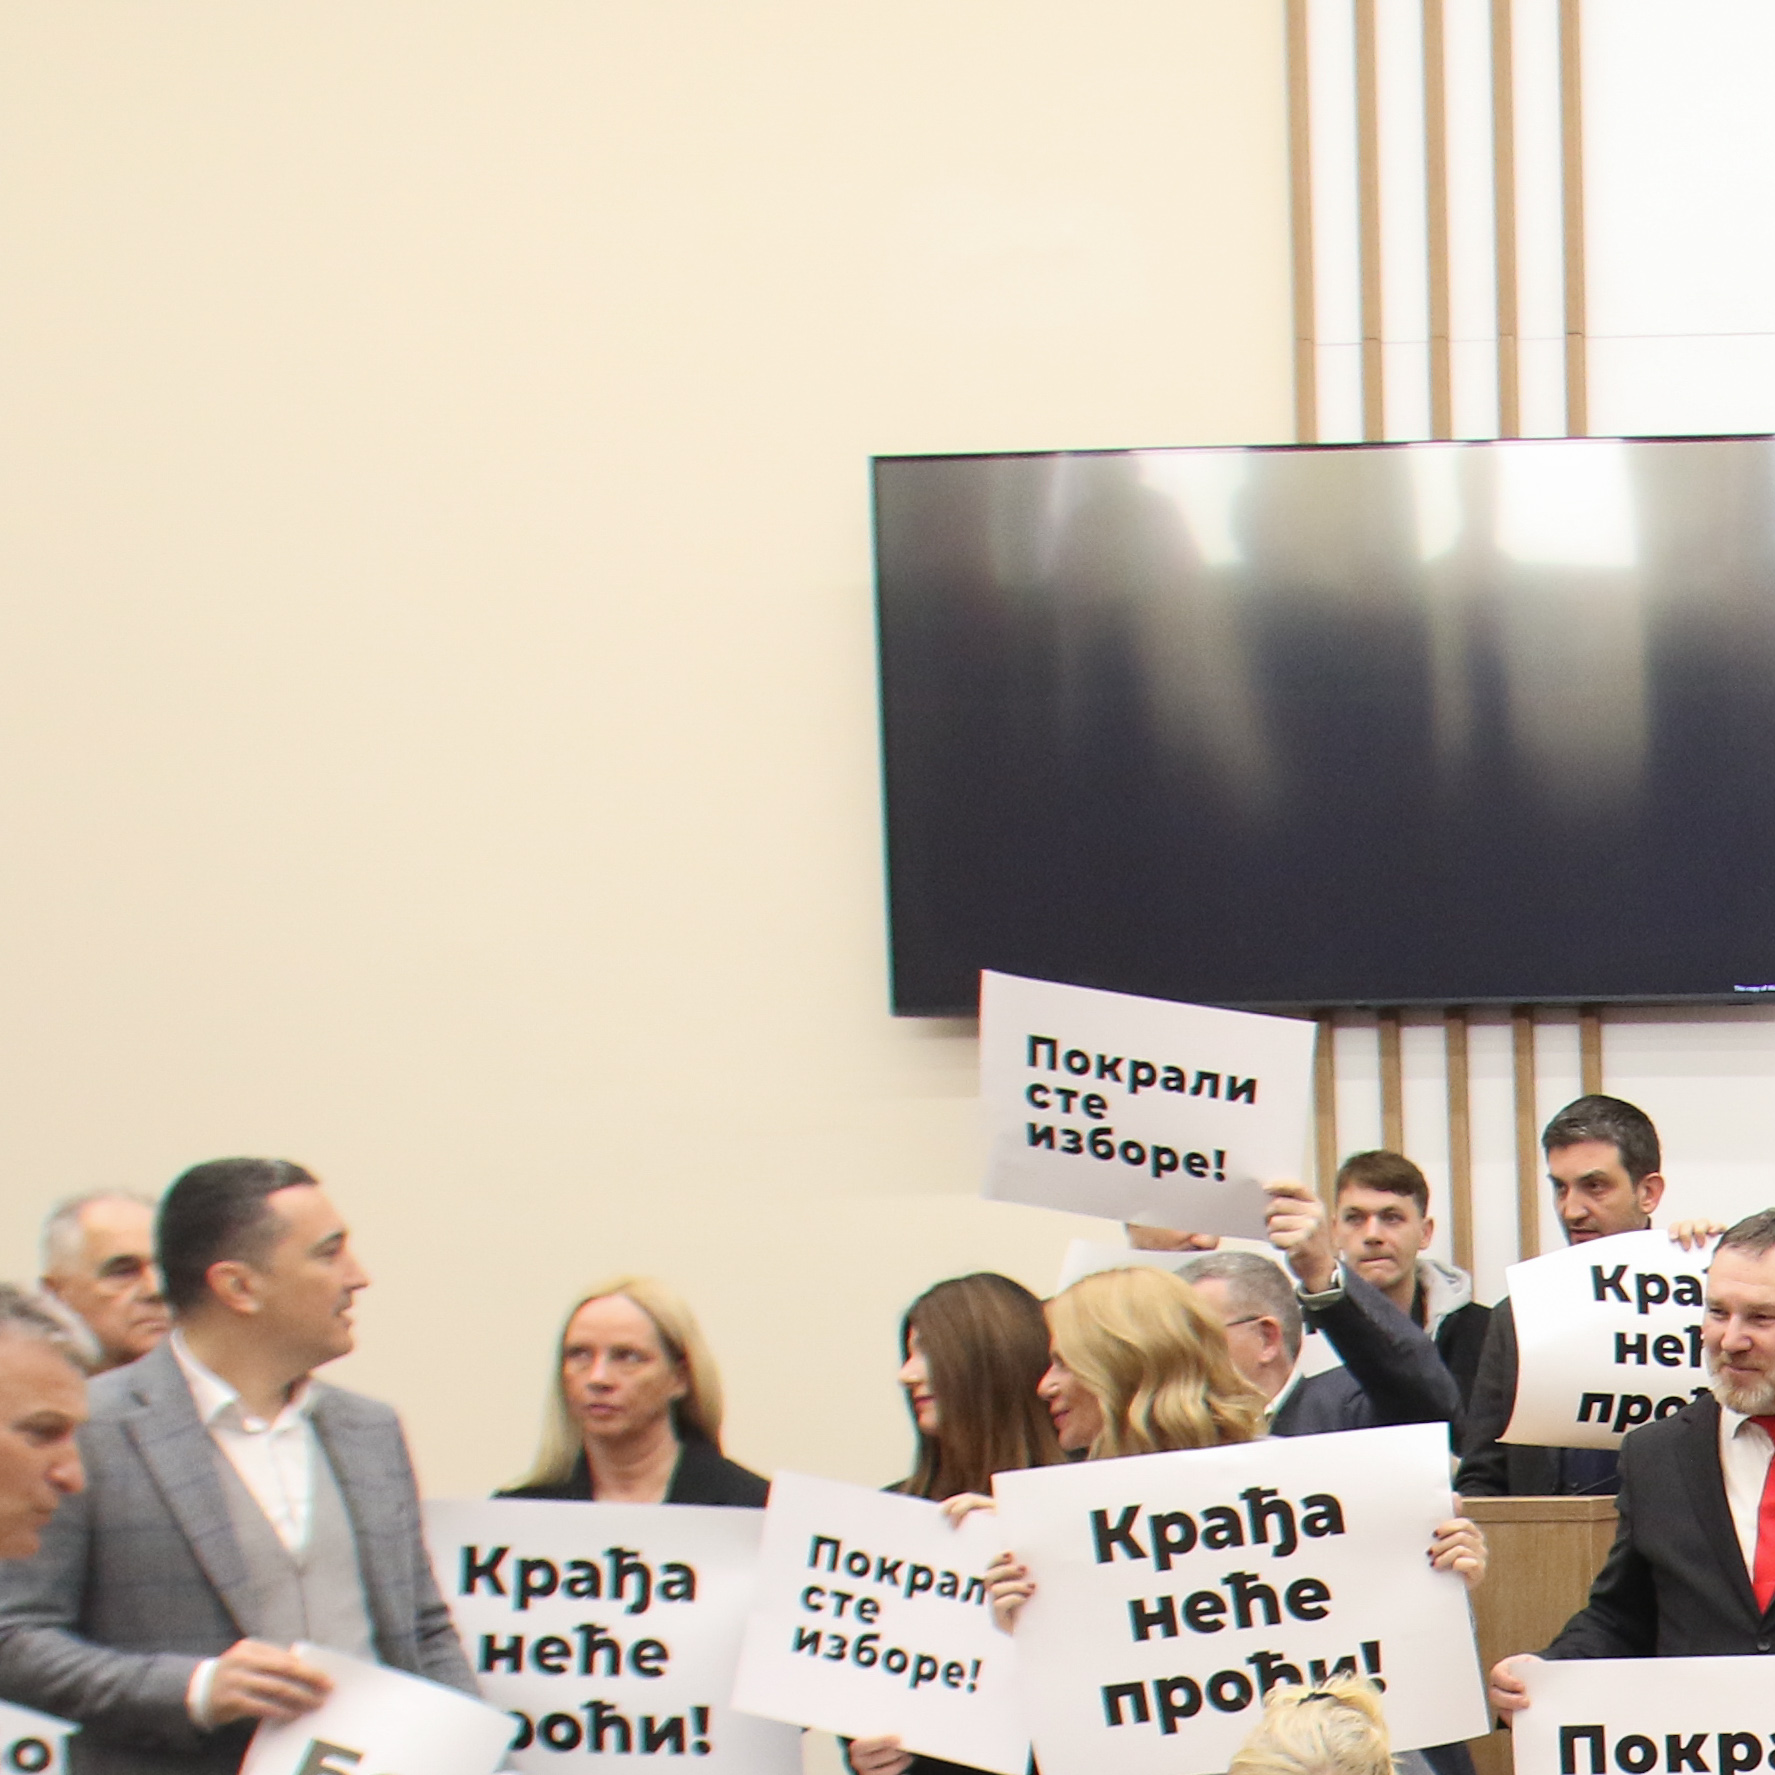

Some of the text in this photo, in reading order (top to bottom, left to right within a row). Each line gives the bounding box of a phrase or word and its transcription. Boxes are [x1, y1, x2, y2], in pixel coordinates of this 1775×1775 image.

[1026, 1034, 1257, 1105] Покрали
[1024, 1082, 1108, 1120] сте
[1025, 1122, 1226, 1183] изборе!
[1592, 1265, 1702, 1314] Кра
[1616, 1325, 1704, 1367] не
[1577, 1387, 1711, 1433] про
[1089, 1486, 1346, 1572] Крађа
[459, 1545, 696, 1615] Крађа
[807, 1535, 987, 1605] Покрал
[801, 1585, 880, 1624] сте
[1126, 1571, 1331, 1642] неће
[476, 1623, 669, 1678] неће
[793, 1627, 982, 1692] изборе!
